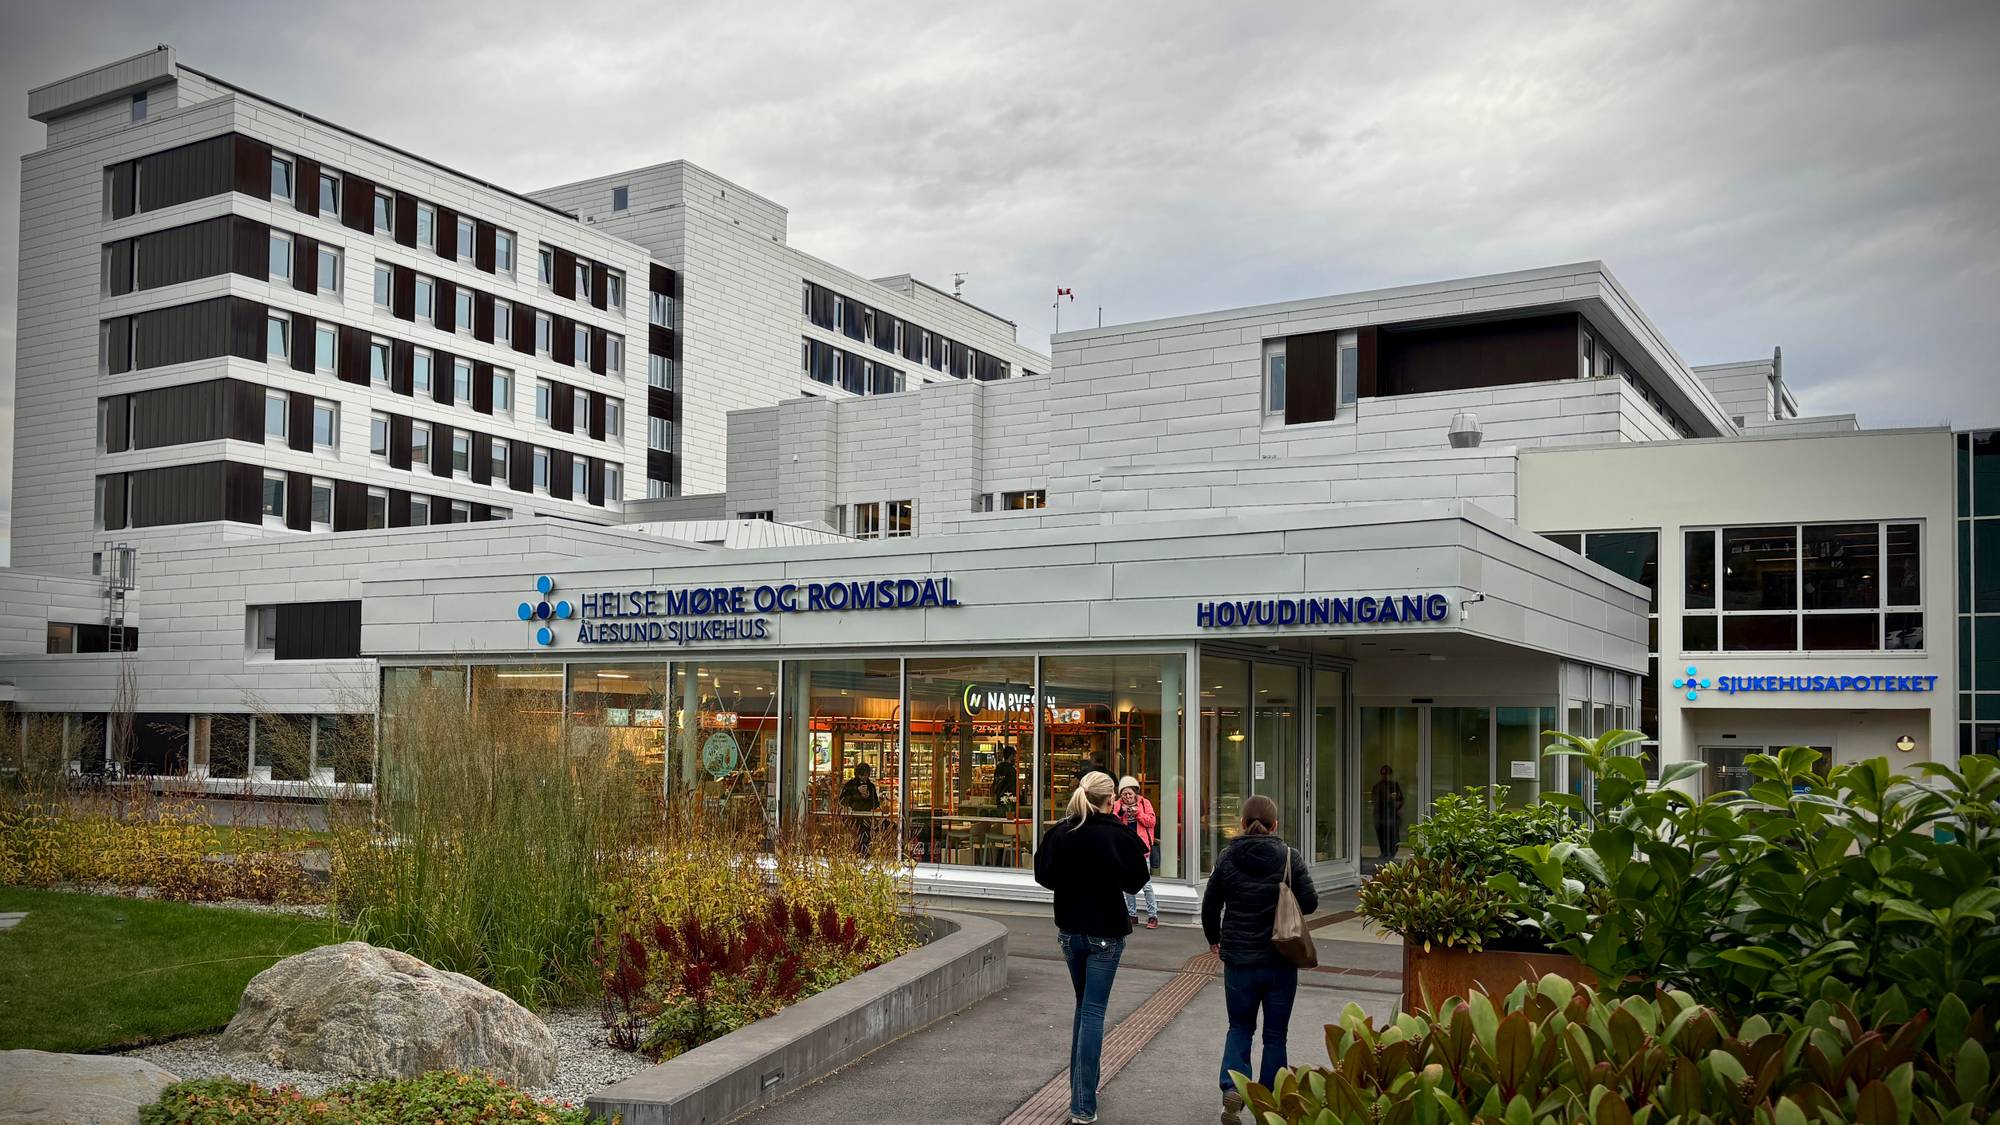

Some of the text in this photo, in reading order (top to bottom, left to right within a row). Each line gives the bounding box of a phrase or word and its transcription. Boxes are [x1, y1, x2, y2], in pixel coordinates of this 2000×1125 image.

[581, 577, 957, 617] HELSE MØRE OG ROMSDAL
[1197, 594, 1449, 627] HOVUDINNGANG
[577, 618, 767, 646] ÅLESUND SJUKEHUS
[1718, 675, 1938, 695] SJUKEHUSAPOTEKET
